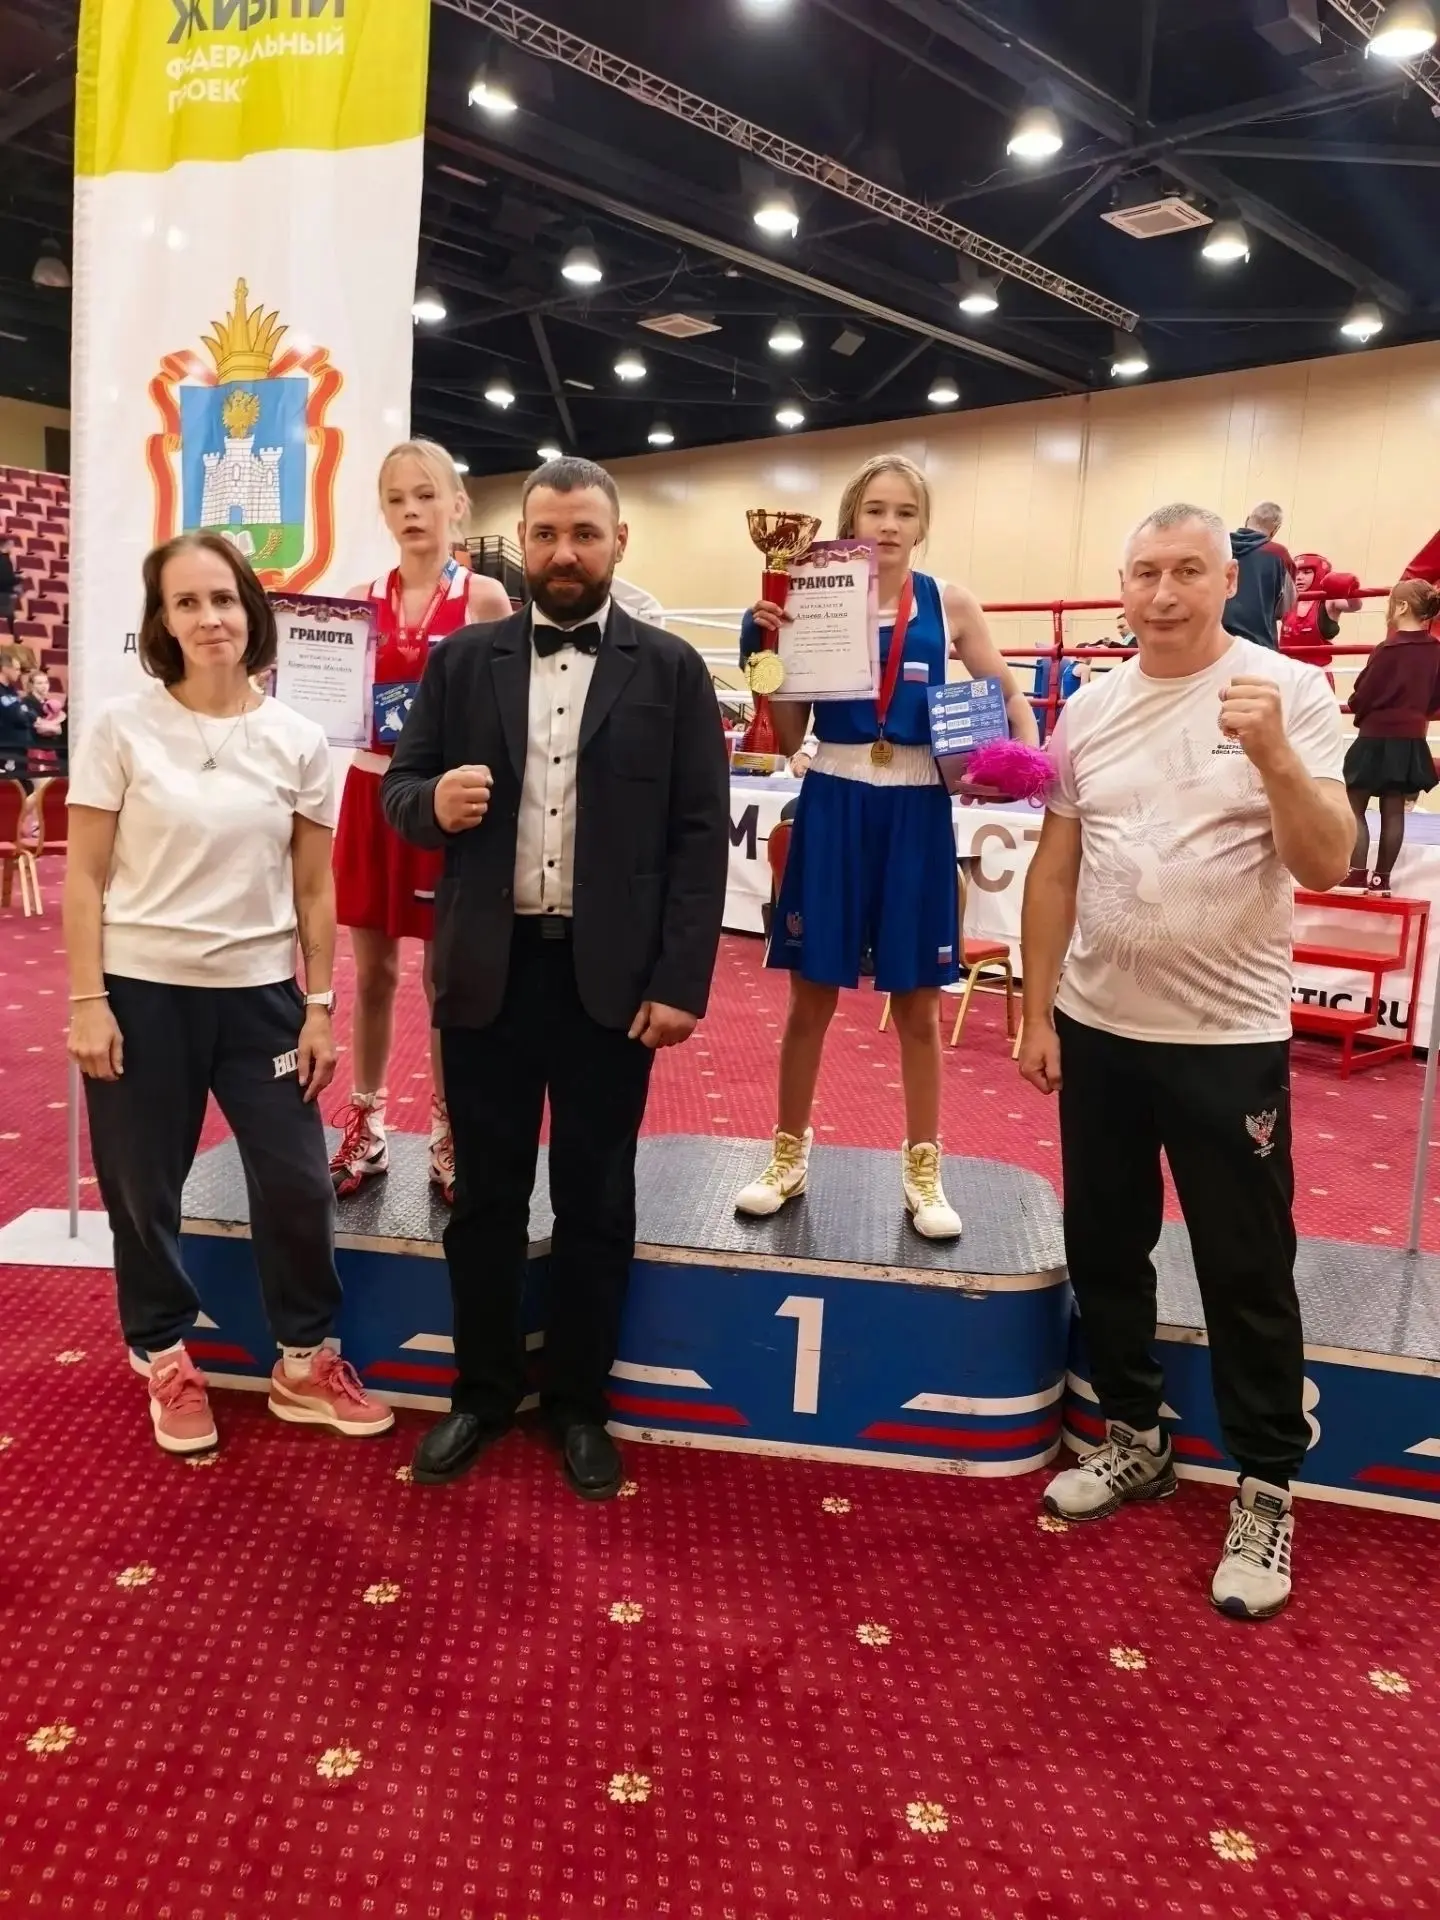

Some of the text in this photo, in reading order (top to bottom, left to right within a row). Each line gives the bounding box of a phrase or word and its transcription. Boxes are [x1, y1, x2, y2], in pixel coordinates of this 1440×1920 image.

[166, 26, 345, 80] ФДЕРАЛЬНЫЙ
[168, 74, 249, 114] ПОЕК
[787, 574, 855, 591] ГРАМОТА
[289, 627, 354, 645] ГРАМОТА
[774, 1295, 824, 1414] 1
